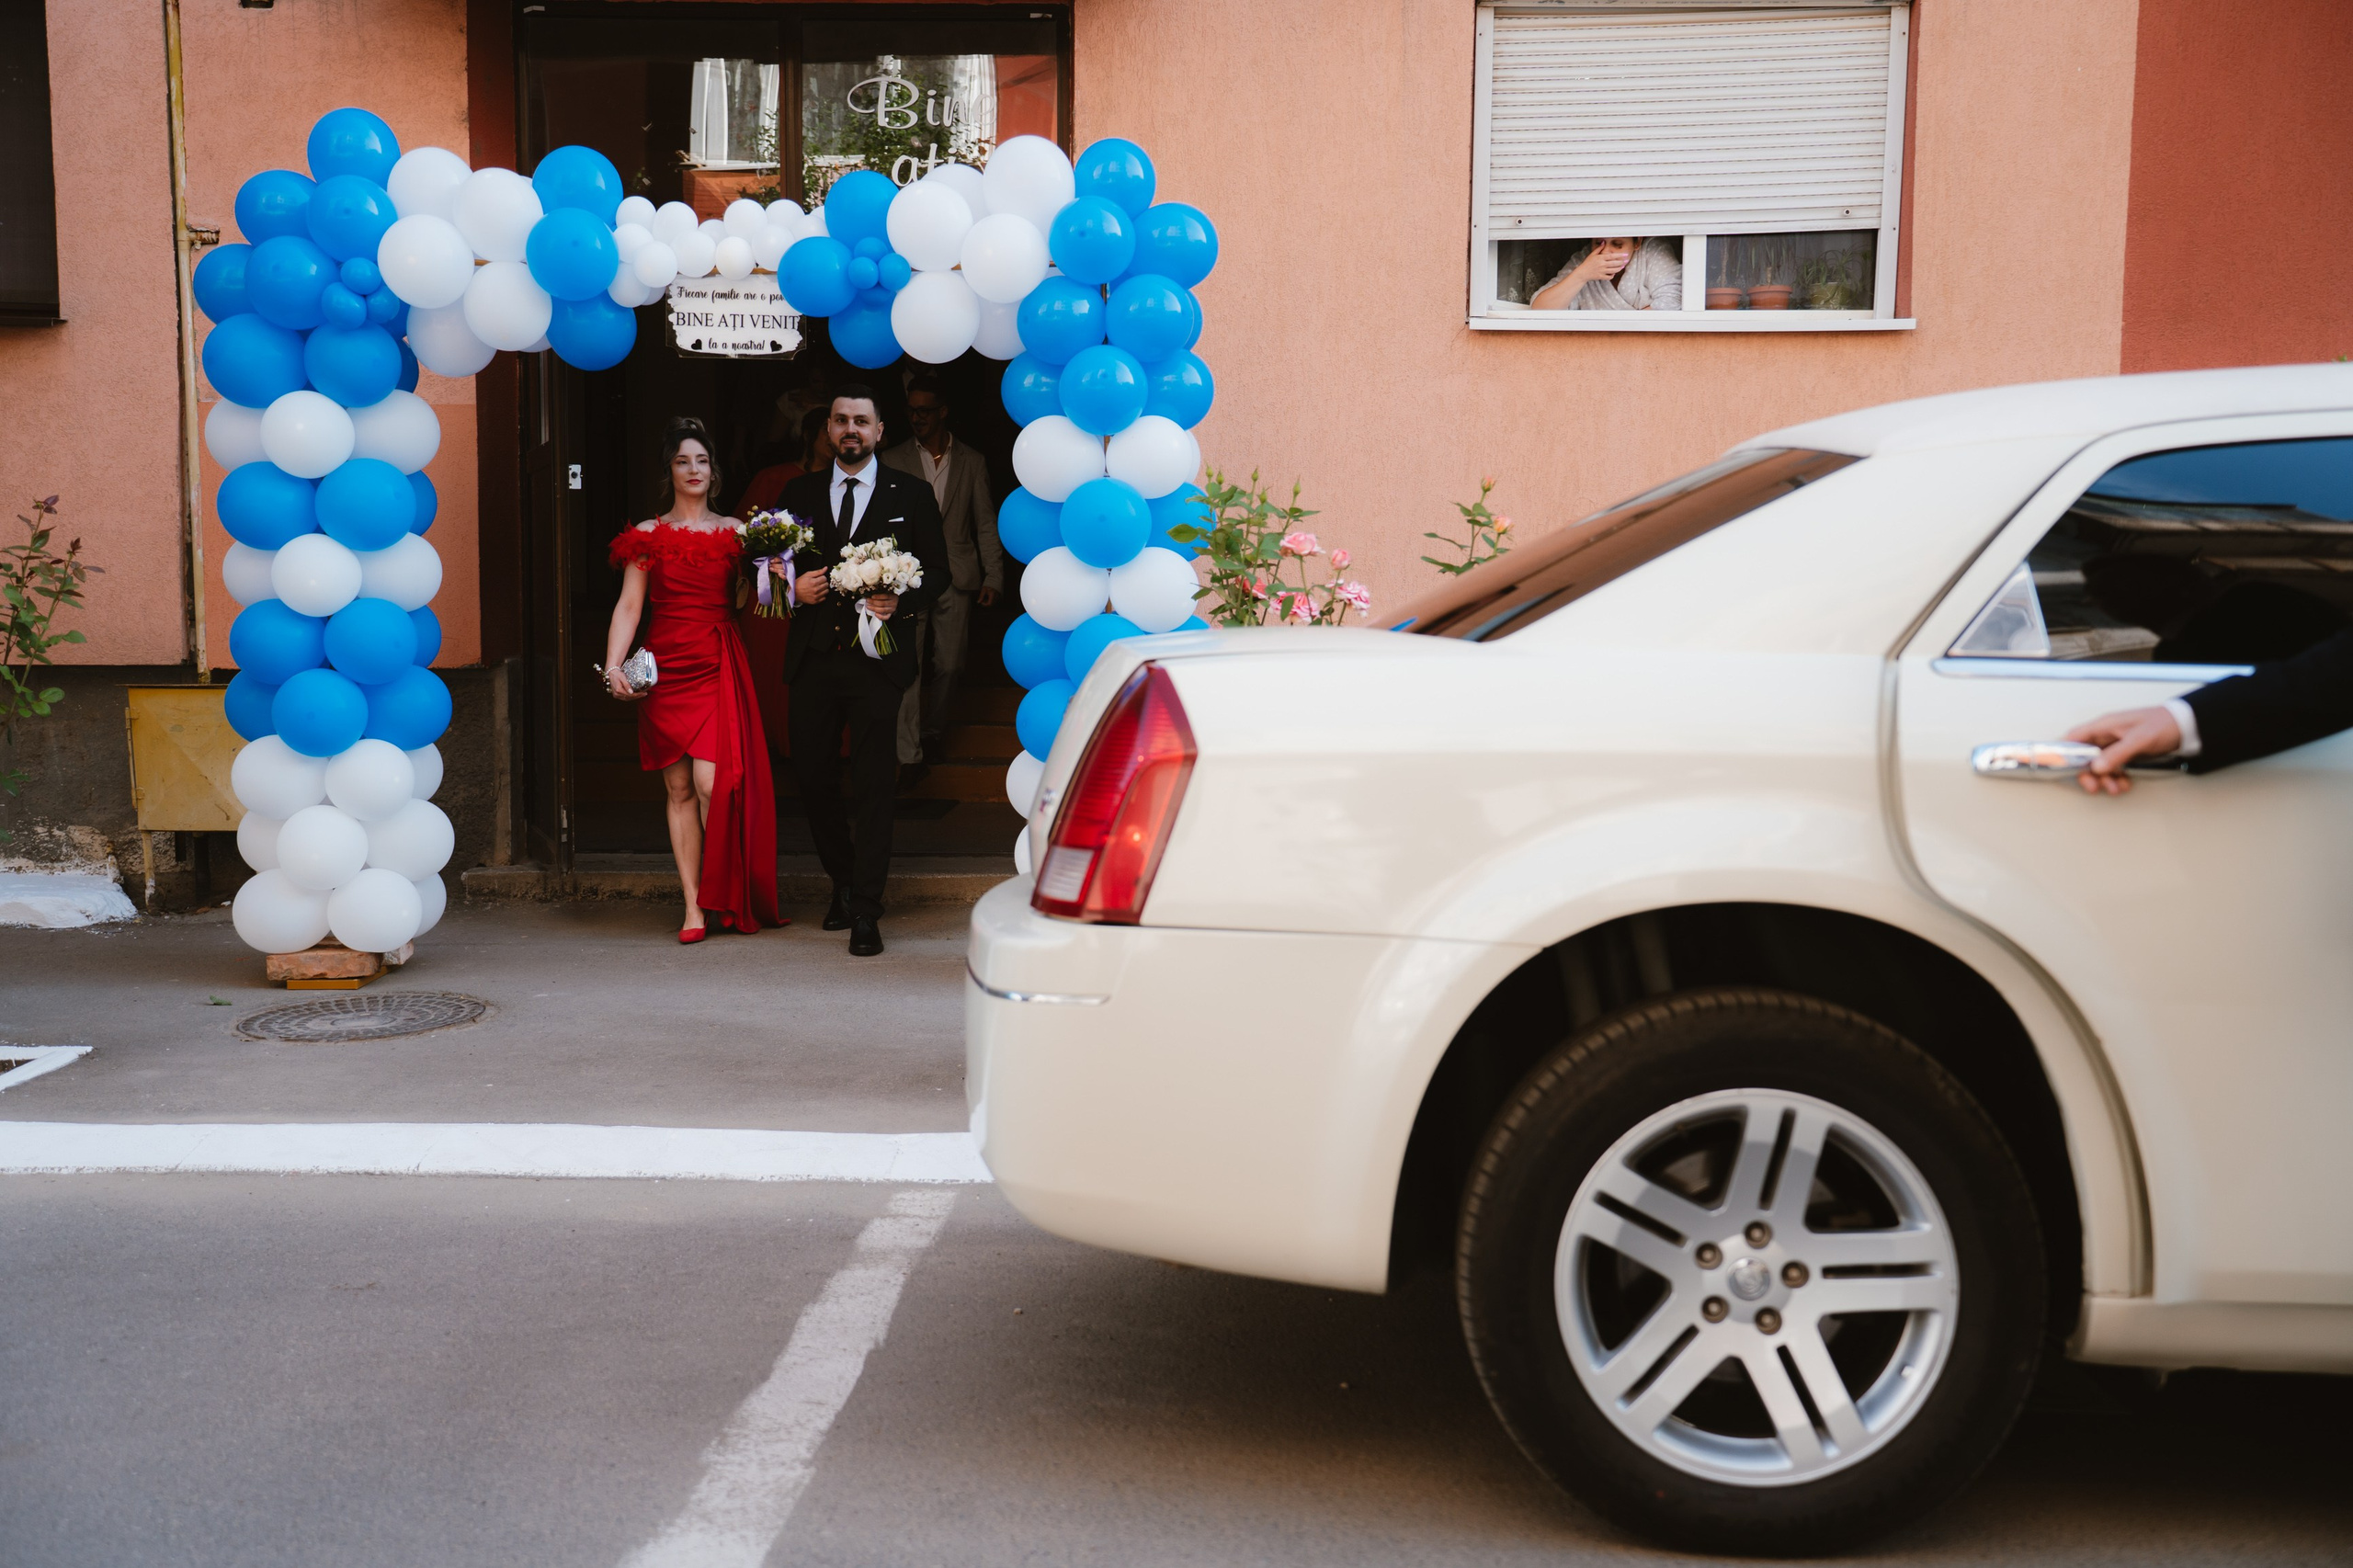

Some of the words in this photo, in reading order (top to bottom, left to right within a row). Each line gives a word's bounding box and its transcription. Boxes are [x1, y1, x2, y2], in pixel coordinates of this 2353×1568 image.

[847, 76, 997, 130] Bine
[676, 286, 708, 298] Fiecare
[711, 289, 740, 303] familie
[744, 290, 757, 300] are
[760, 292, 767, 301] o
[676, 312, 713, 326] BINE
[750, 314, 799, 329] VENIT
[709, 337, 718, 348] la
